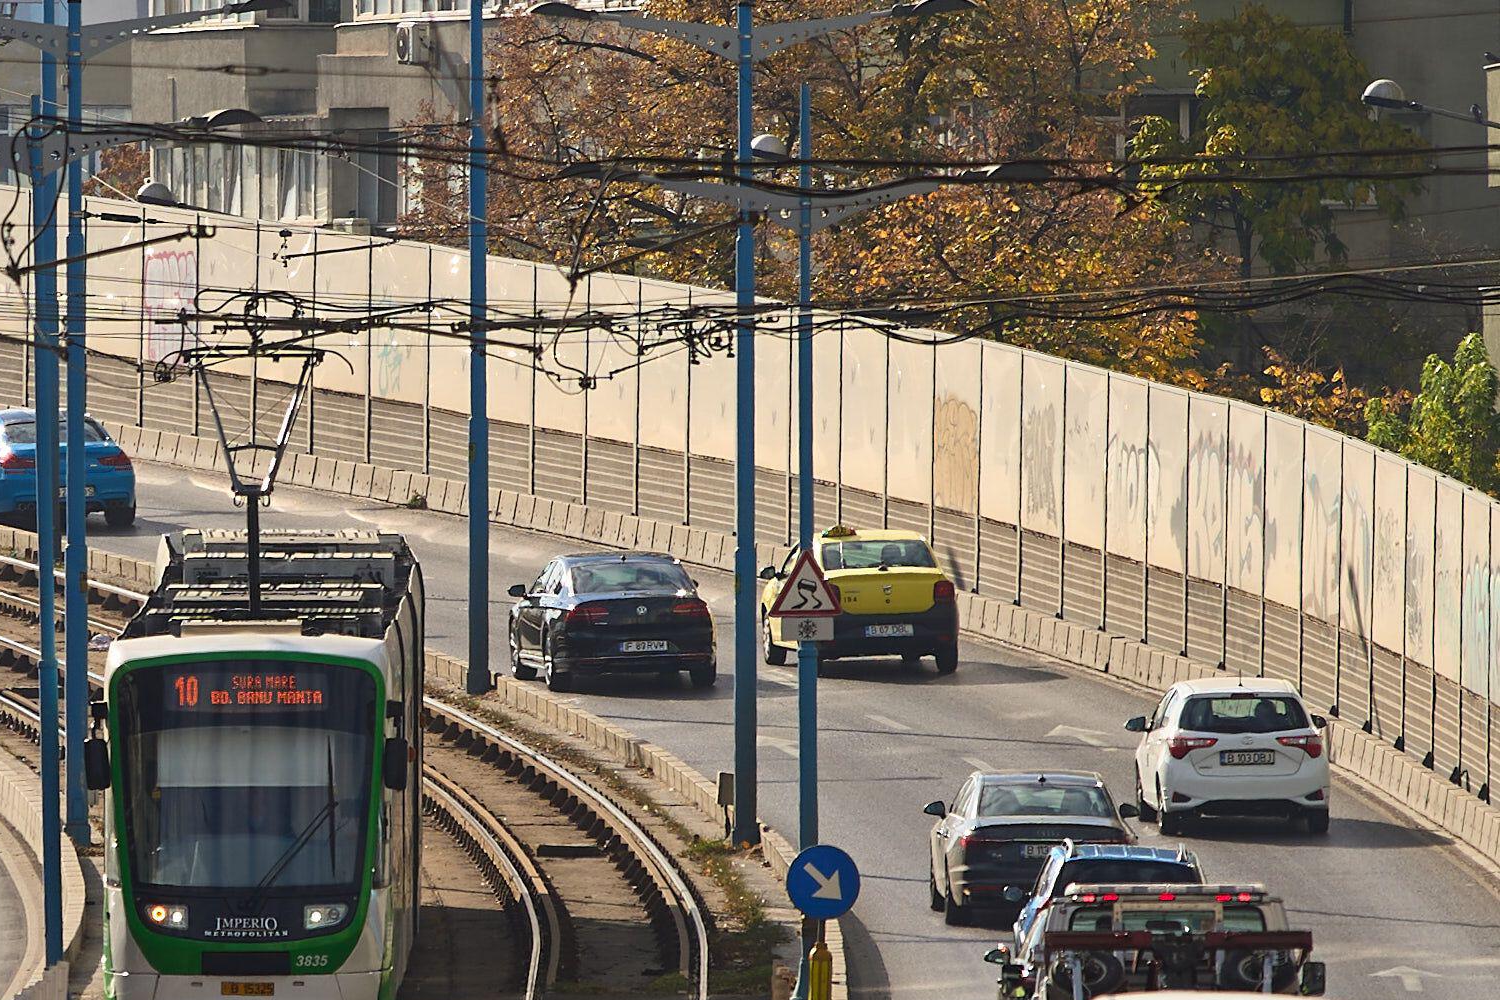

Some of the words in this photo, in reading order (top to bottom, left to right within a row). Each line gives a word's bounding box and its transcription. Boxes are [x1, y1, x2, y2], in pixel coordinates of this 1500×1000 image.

[175, 675, 199, 707] 10
[265, 674, 297, 689] MARE
[210, 691, 233, 705] BD.
[237, 691, 273, 705] BANU
[277, 691, 323, 704] MANTA
[215, 917, 278, 931] IMPERIO
[295, 954, 328, 967] 3835
